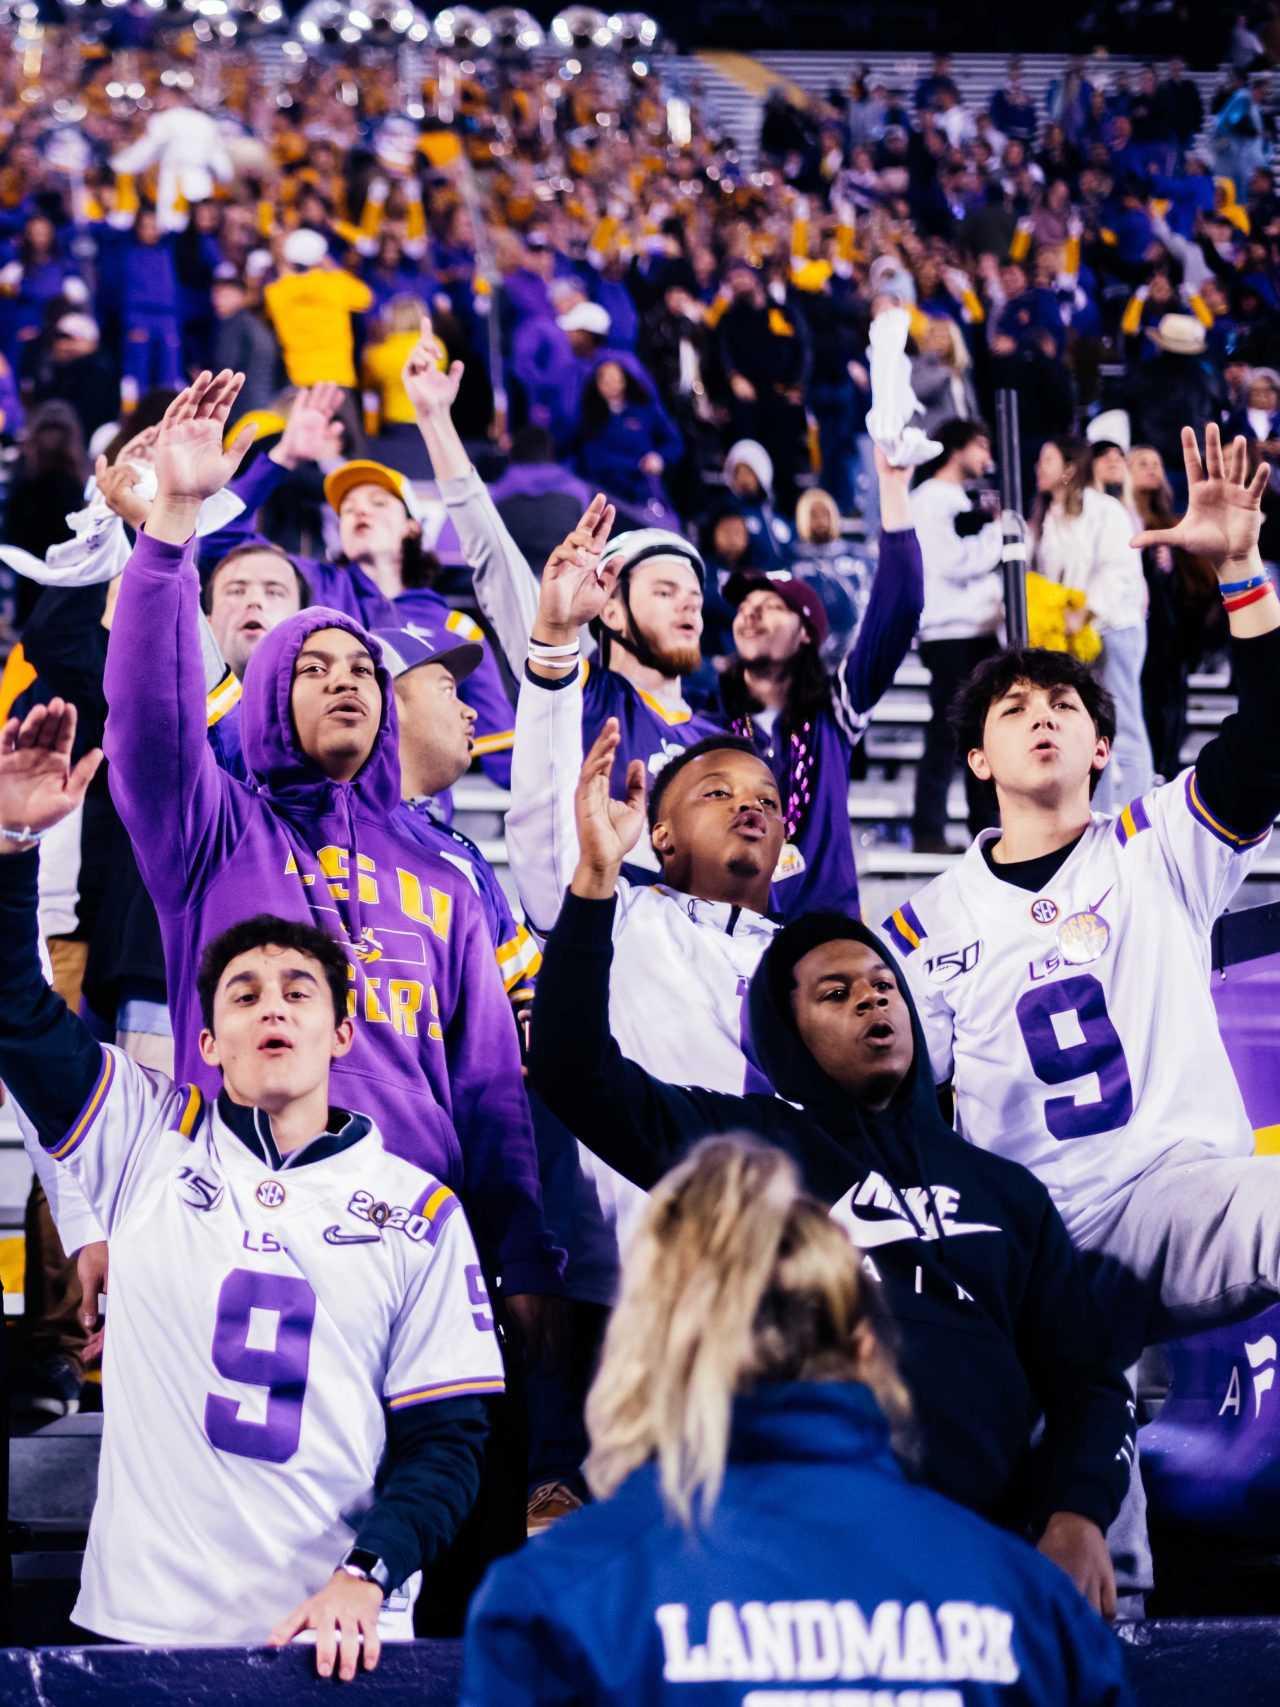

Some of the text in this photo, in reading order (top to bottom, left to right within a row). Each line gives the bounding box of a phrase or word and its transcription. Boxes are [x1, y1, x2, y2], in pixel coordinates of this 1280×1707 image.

[1033, 900, 1056, 922] SEC
[924, 939, 981, 982] 150
[1015, 973, 1134, 1142] 9
[347, 1190, 432, 1242] 2020
[204, 1267, 317, 1465] 9
[655, 1600, 1019, 1685] LANDMARK
